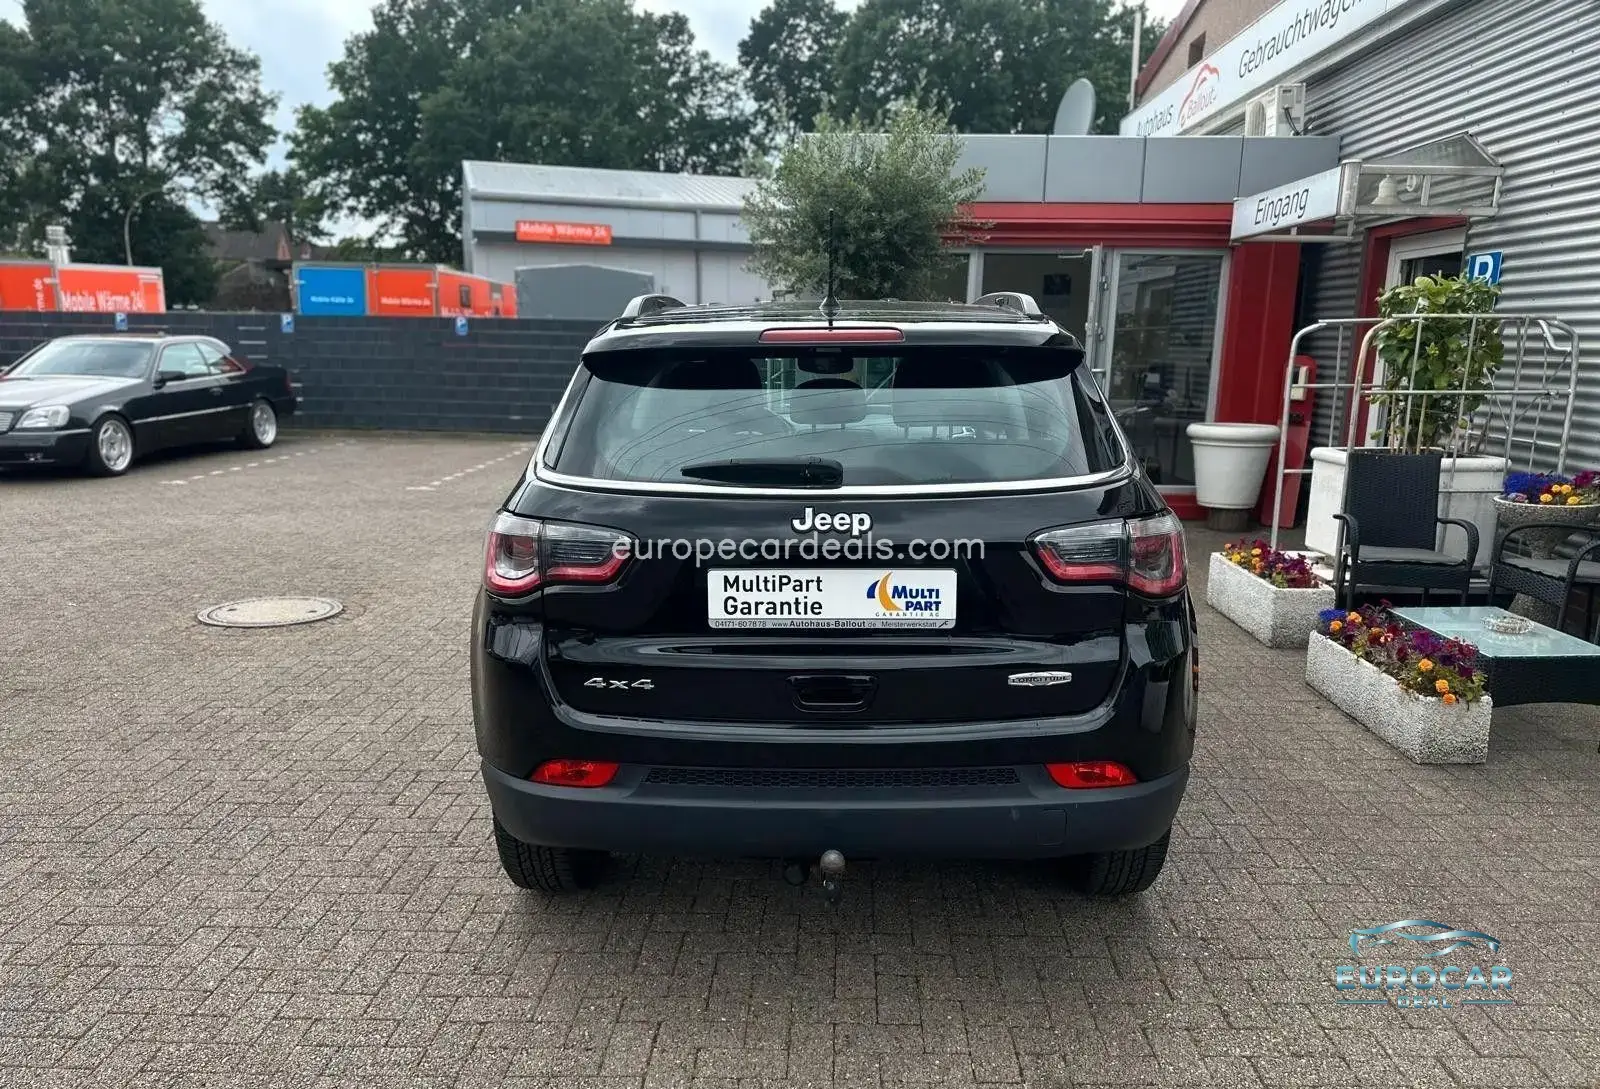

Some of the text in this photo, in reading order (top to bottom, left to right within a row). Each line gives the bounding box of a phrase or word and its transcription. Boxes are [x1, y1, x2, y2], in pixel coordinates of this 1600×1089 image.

[1254, 188, 1309, 226] Eingang
[520, 221, 553, 235] Mobile
[61, 289, 96, 311] Mobile
[792, 507, 871, 536] Jeep
[723, 575, 823, 592] MultiPart
[723, 596, 823, 615] Garantie
[905, 601, 941, 611] PART
[881, 620, 937, 628] Meisterwerkstatt
[583, 677, 655, 690] 4x4
